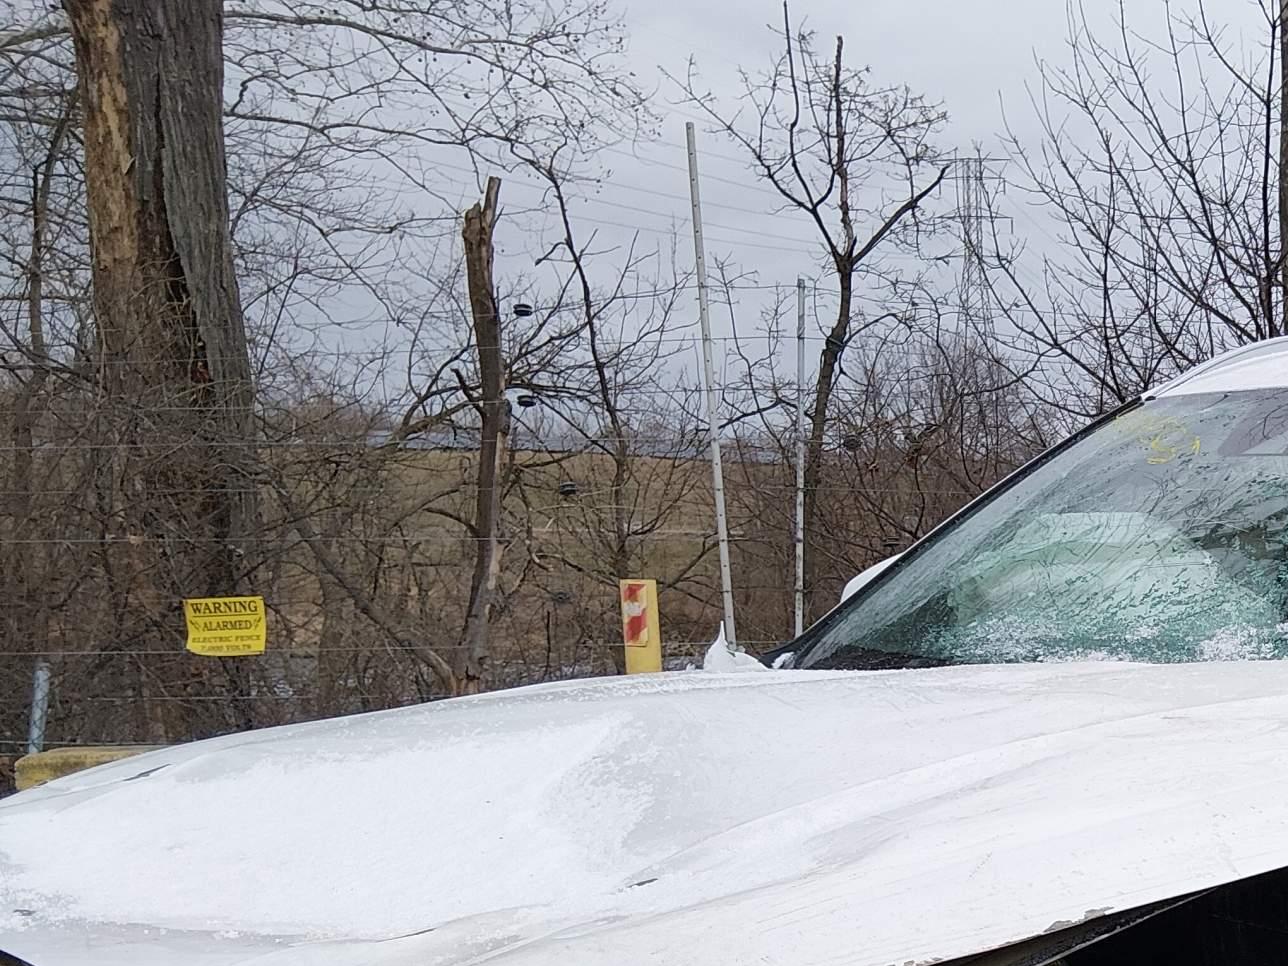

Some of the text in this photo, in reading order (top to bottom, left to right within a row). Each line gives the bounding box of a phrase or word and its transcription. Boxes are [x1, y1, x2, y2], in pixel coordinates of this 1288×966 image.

[190, 600, 258, 615] WARNING
[202, 619, 253, 632] ALARMED
[191, 634, 261, 643] ELECTRIC FENCE
